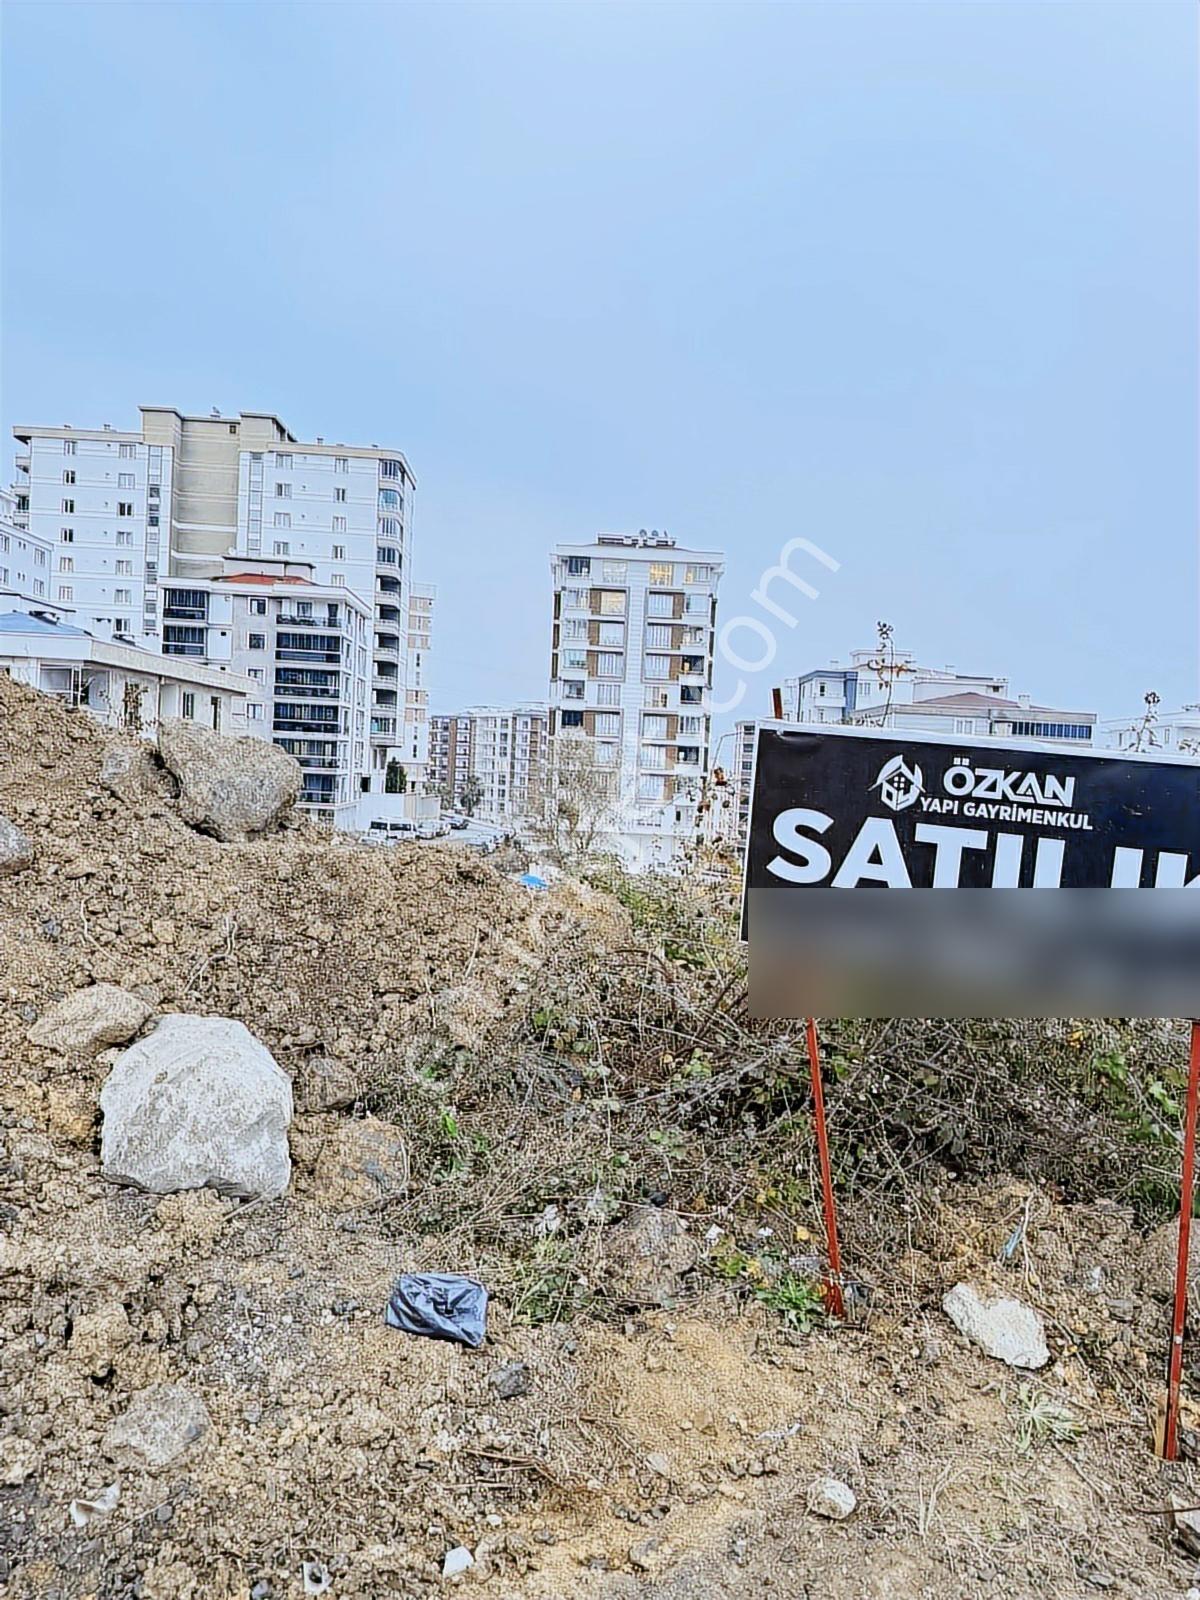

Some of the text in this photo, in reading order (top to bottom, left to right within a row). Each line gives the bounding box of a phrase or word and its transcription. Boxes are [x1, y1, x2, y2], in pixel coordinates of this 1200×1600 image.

[943, 757, 1077, 808] ÖZKAN
[920, 797, 1093, 830] YAPI GAYRİMENKUL
